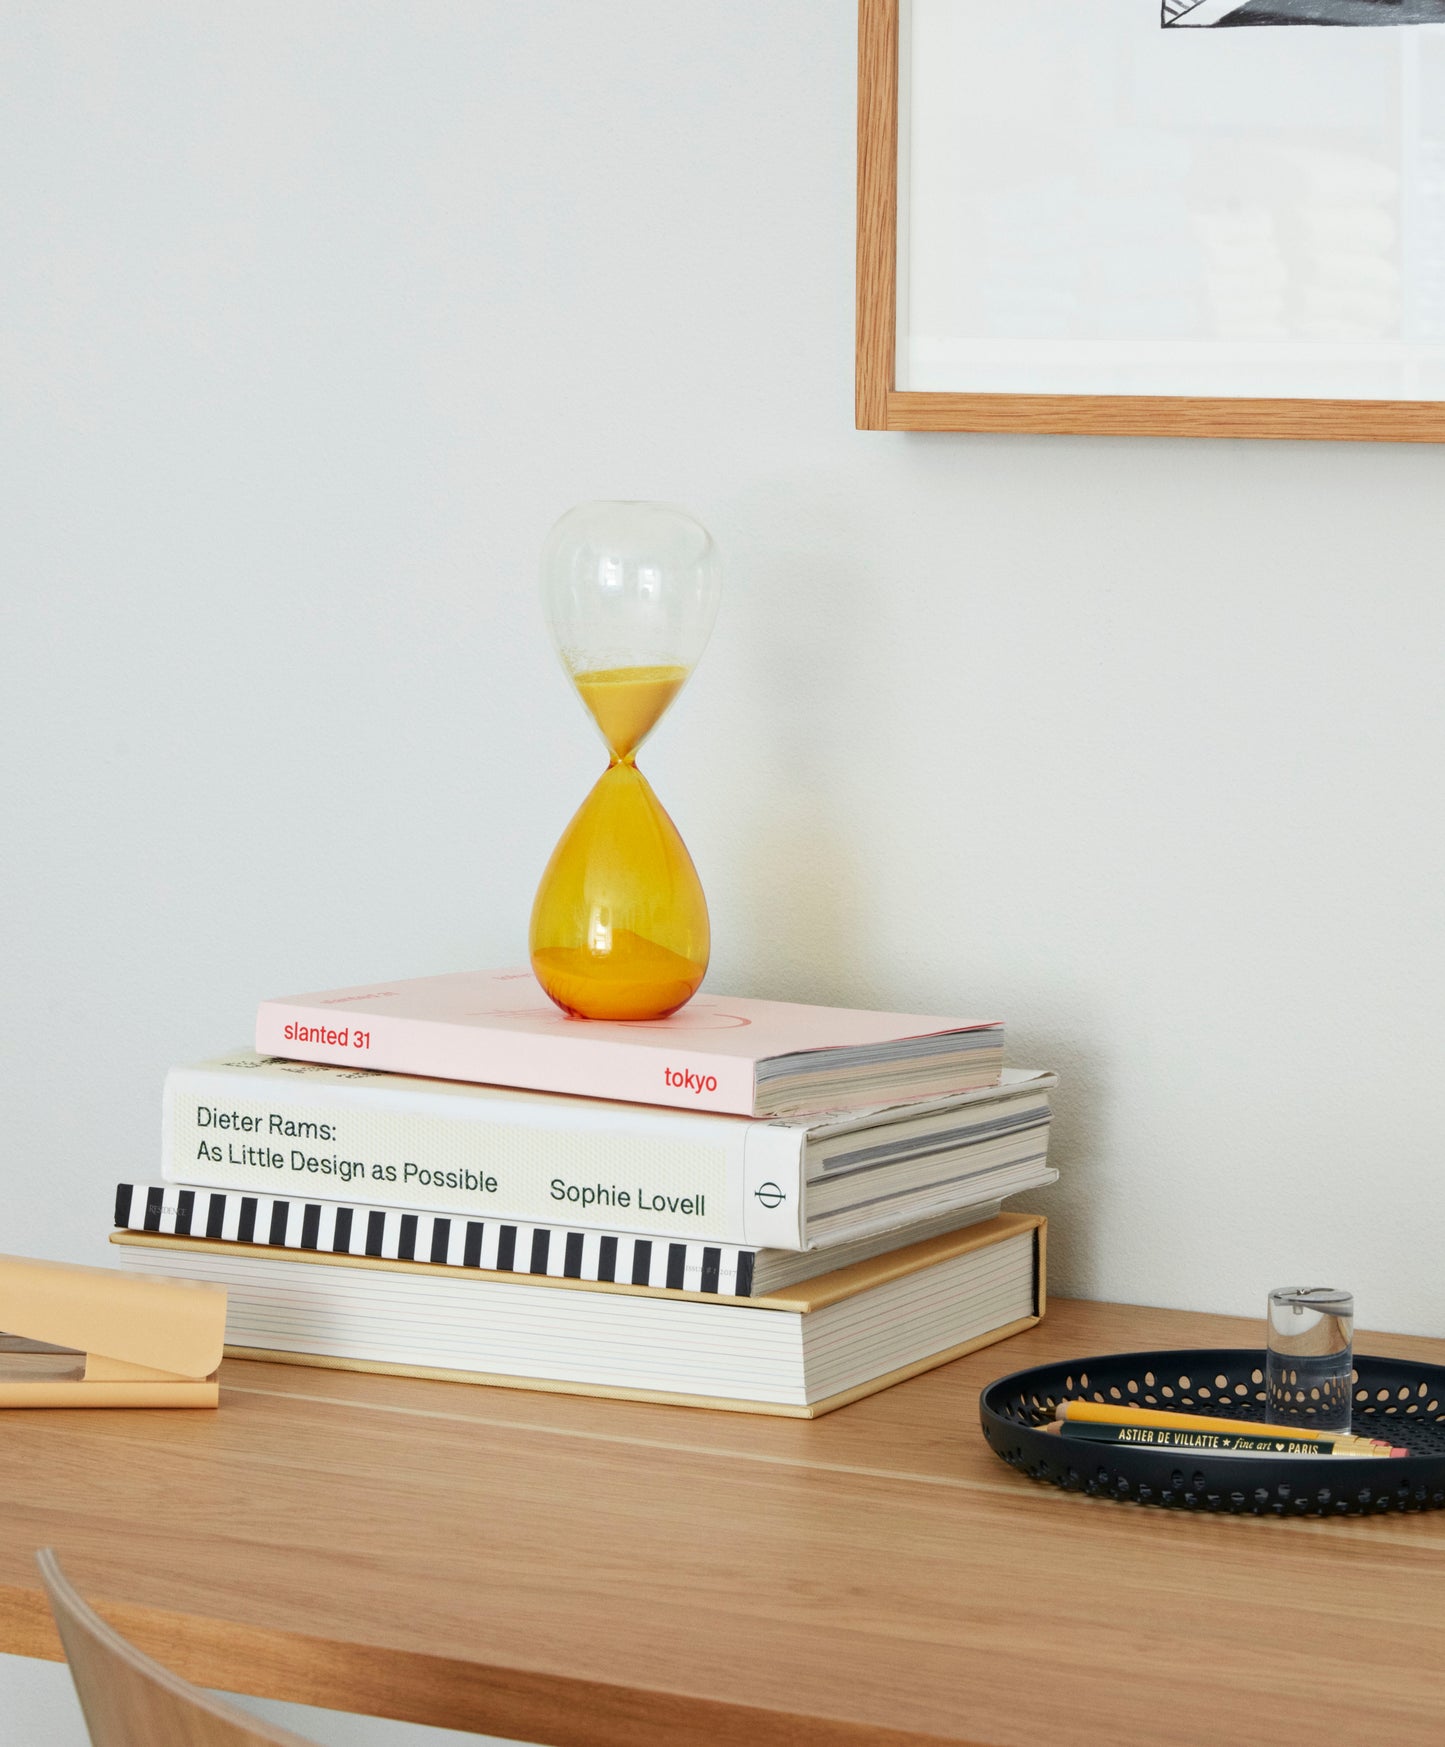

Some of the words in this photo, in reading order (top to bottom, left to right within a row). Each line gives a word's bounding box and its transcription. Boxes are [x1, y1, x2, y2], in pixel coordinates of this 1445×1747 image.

[284, 1021, 349, 1047] slanted
[353, 1030, 371, 1050] 31
[664, 1066, 718, 1095] tokyo
[197, 1106, 263, 1133] Dieter
[269, 1113, 337, 1142] Rams:
[197, 1140, 223, 1162] As
[228, 1143, 284, 1169] Little
[290, 1150, 365, 1182] Design
[371, 1164, 397, 1182] as
[403, 1162, 498, 1193] Possible
[550, 1178, 631, 1209] Sophie
[638, 1188, 705, 1217] Lovell
[1118, 1428, 1154, 1443] ASTIER
[1157, 1431, 1171, 1444] DE
[1174, 1432, 1220, 1448] VILLATTE
[1232, 1437, 1255, 1450] fine
[1256, 1441, 1272, 1451] art
[1287, 1442, 1319, 1455] PARIS
